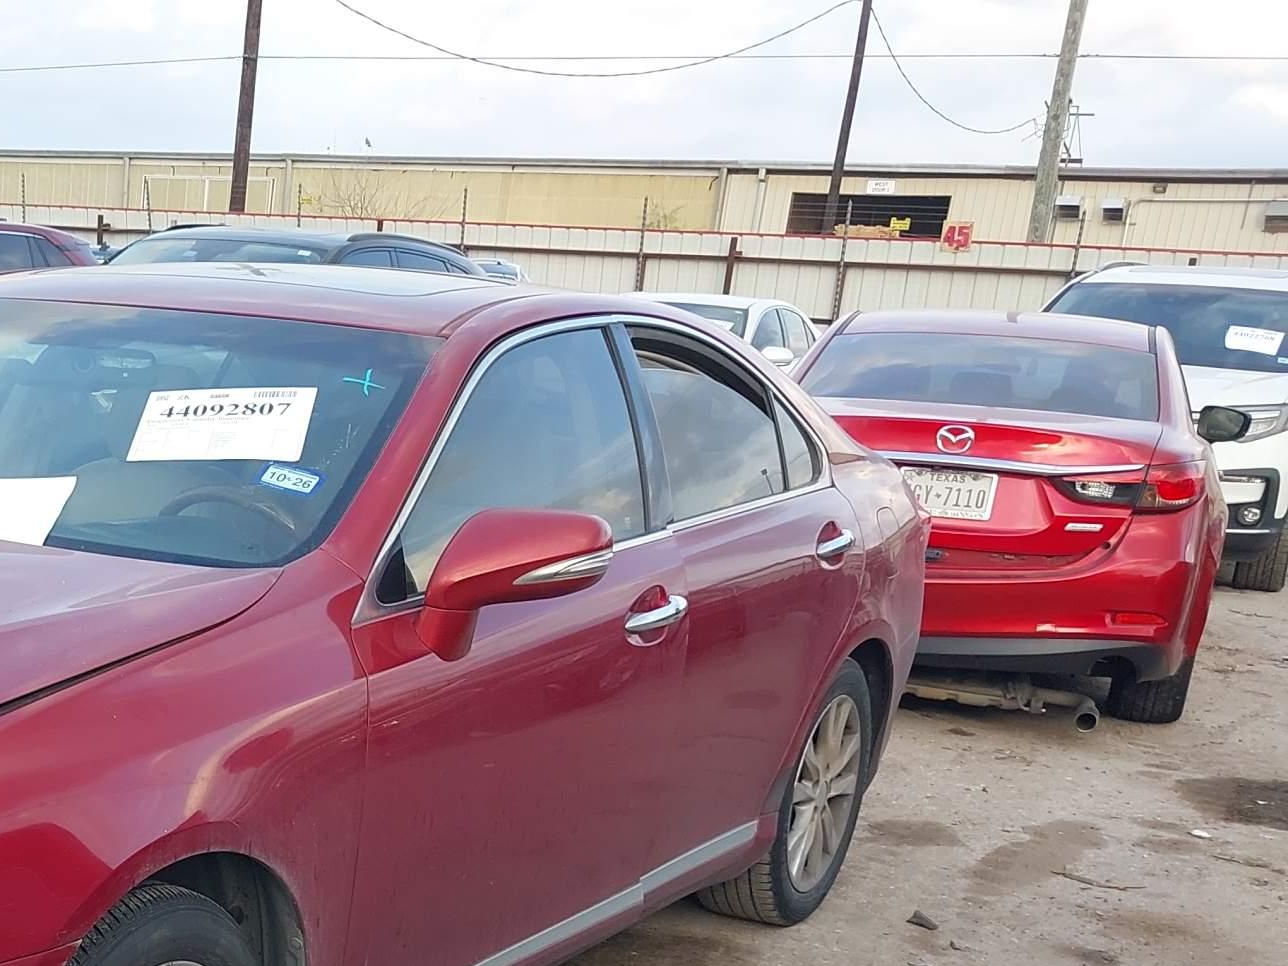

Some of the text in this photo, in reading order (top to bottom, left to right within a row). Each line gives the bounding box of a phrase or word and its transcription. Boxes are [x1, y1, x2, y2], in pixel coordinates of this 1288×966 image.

[942, 225, 972, 249] 45
[160, 403, 291, 418] 44092807
[930, 473, 966, 483] TEXAS
